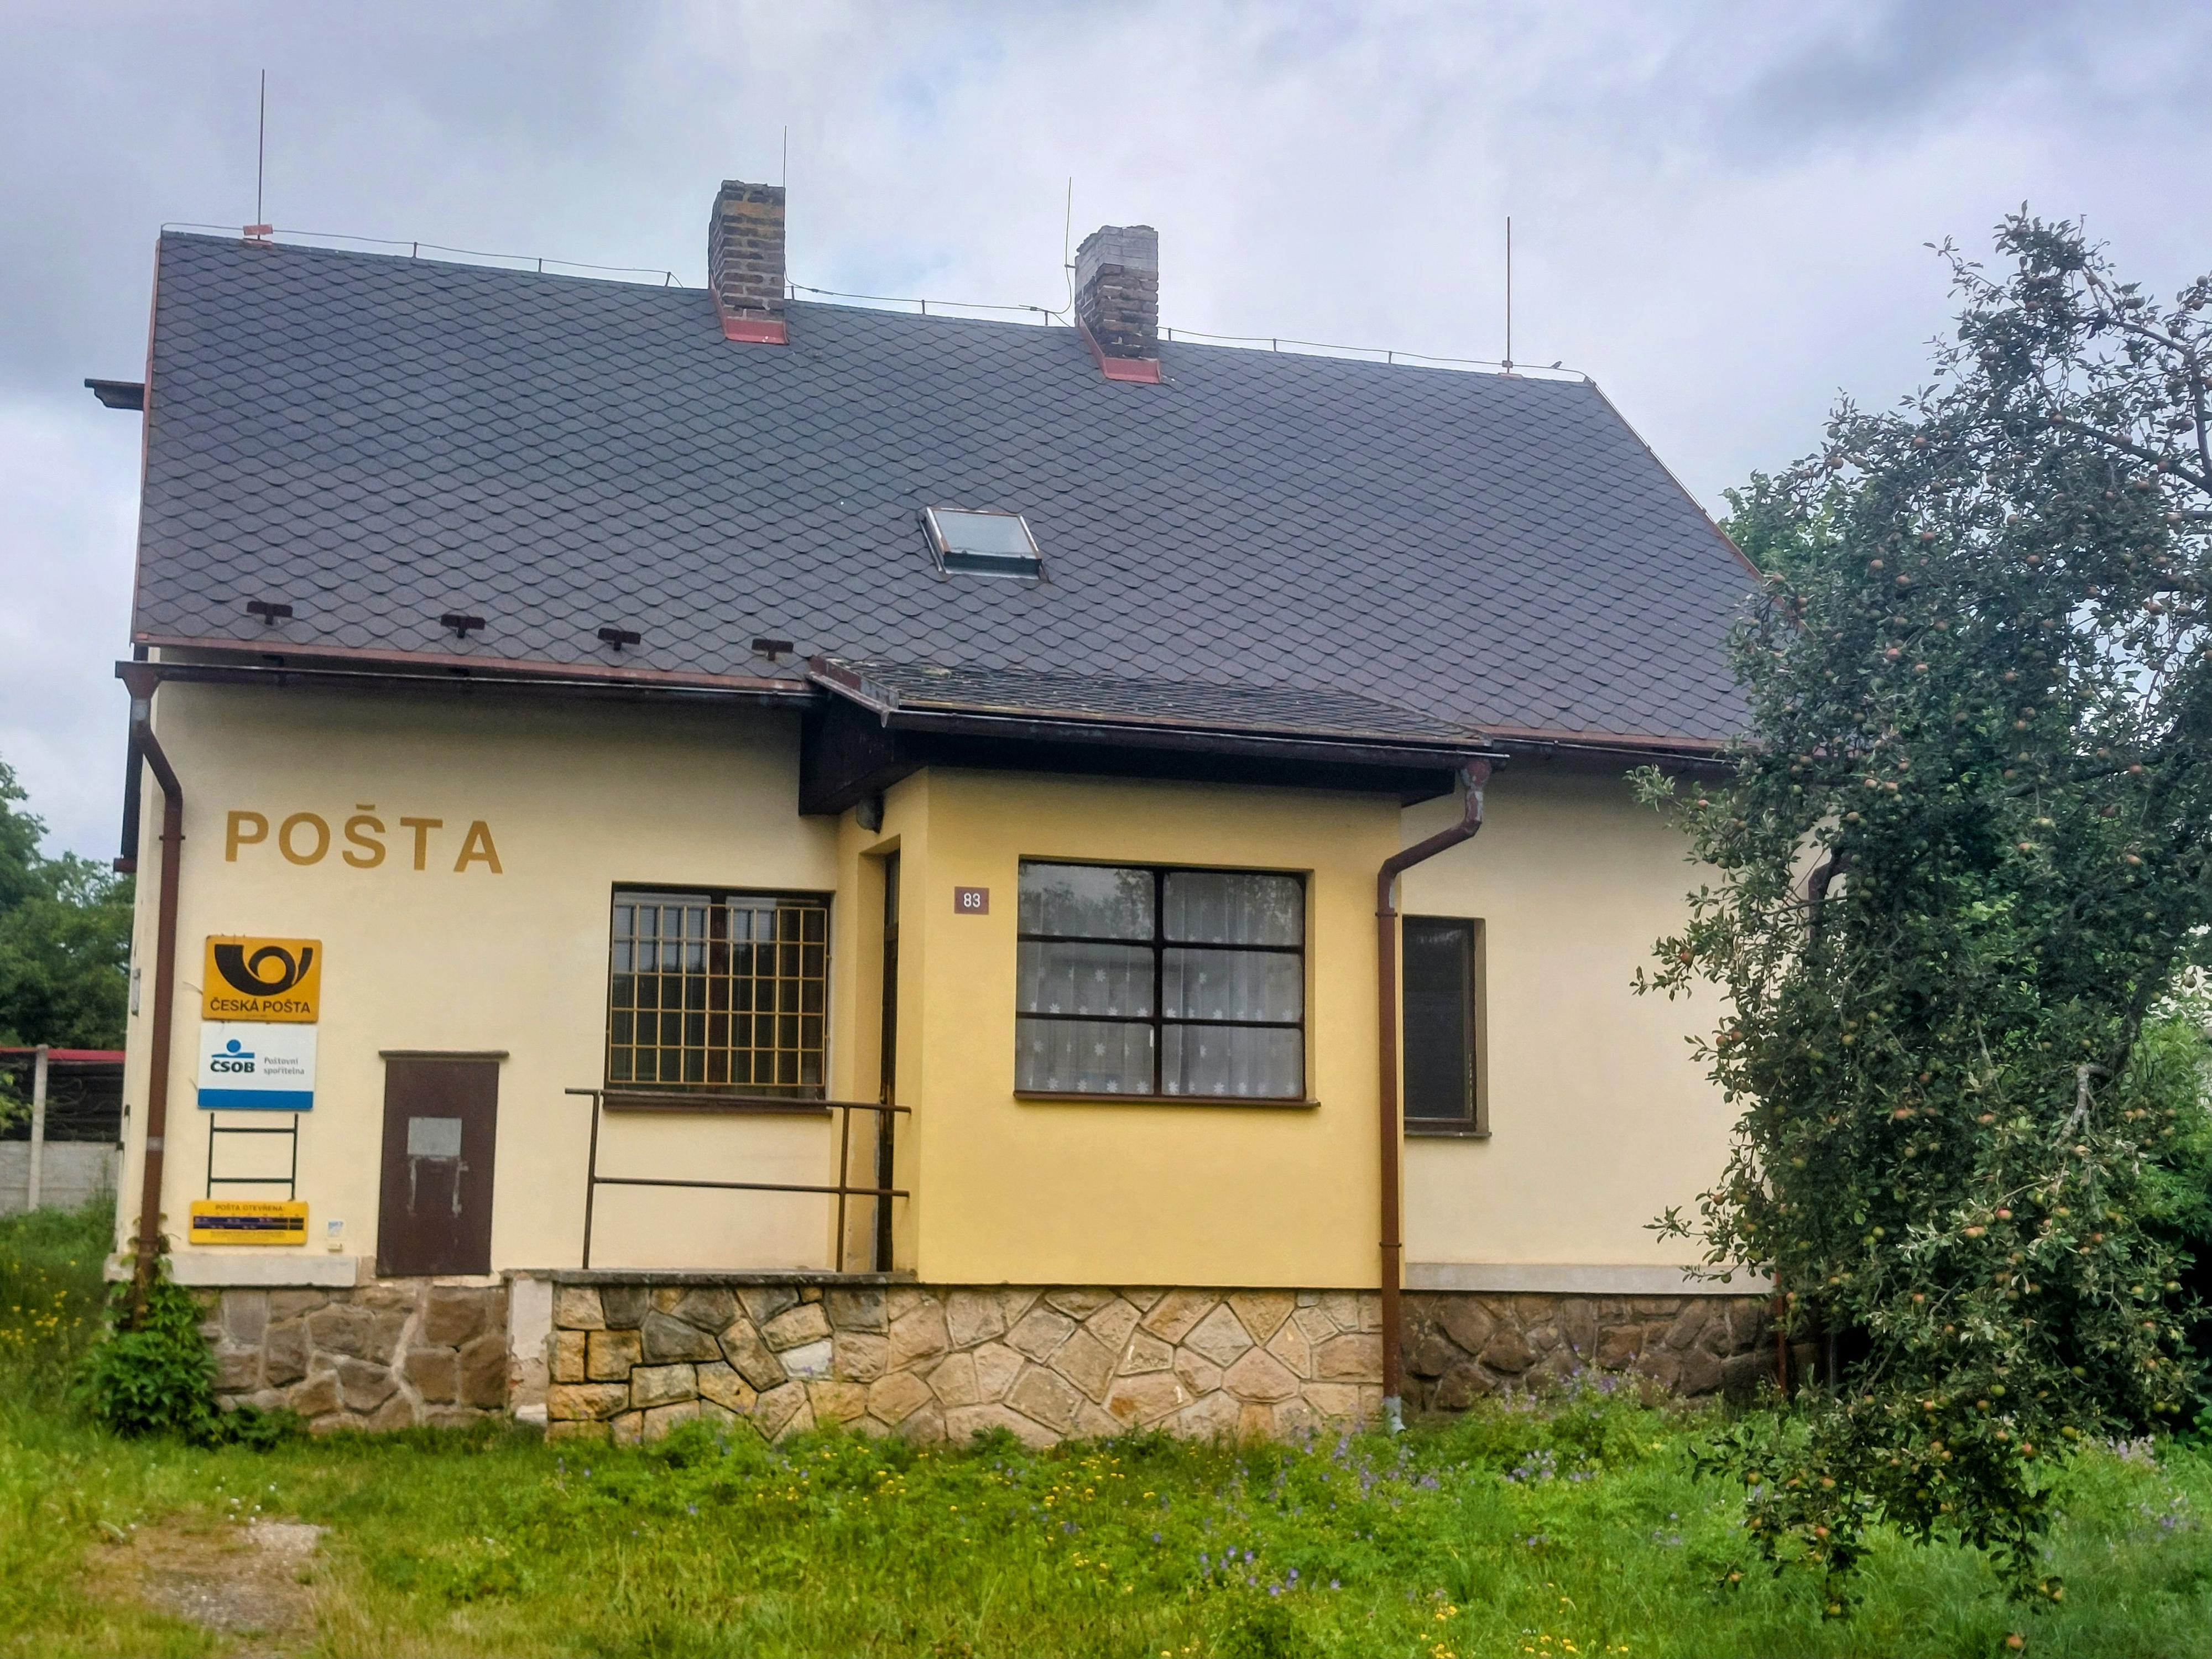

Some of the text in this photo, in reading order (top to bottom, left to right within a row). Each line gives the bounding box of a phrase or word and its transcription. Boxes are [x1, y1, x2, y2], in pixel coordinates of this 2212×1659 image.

[225, 804, 503, 874] POŠTA
[964, 893, 980, 907] 83
[210, 997, 310, 1013] ČESKÁ POŠTA
[210, 1059, 255, 1073] ČSOB
[264, 1057, 298, 1065] Poštovní
[264, 1066, 305, 1076] spořitelna
[215, 1203, 240, 1211] POŠTA
